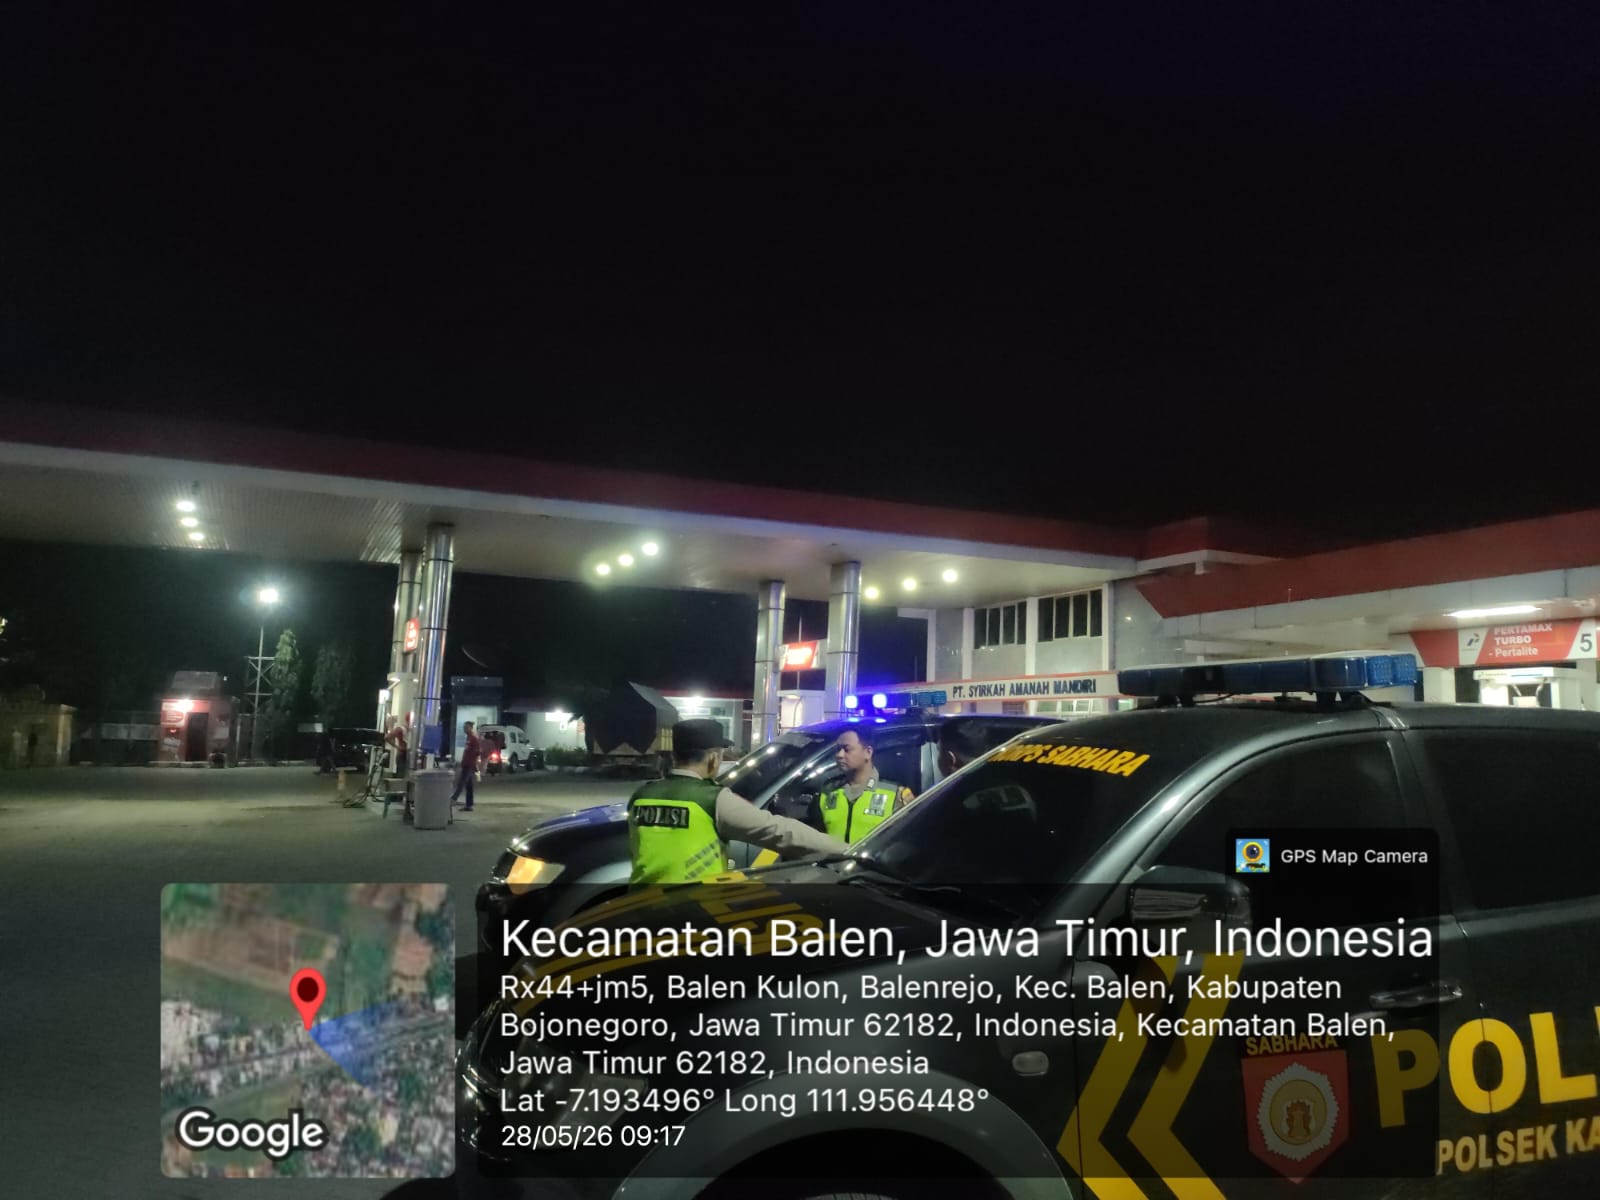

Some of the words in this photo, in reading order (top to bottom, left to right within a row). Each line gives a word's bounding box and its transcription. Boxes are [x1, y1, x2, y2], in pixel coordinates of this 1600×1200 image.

[1494, 623, 1553, 635] PERTAMAX
[1494, 634, 1532, 645] TURBO
[1579, 633, 1593, 653] 5
[1495, 647, 1538, 658] Pertalite
[952, 685, 966, 699] PT.
[968, 684, 1006, 698] SYIRKAH
[1009, 681, 1050, 697] AMANAH
[1053, 678, 1097, 695] MANDIRI
[1036, 745, 1151, 777] SABHARA
[633, 806, 687, 826] POLISI
[1245, 1031, 1338, 1056] SABHARA
[1371, 1006, 1600, 1129] POL
[1436, 1124, 1557, 1176] POLSEK
